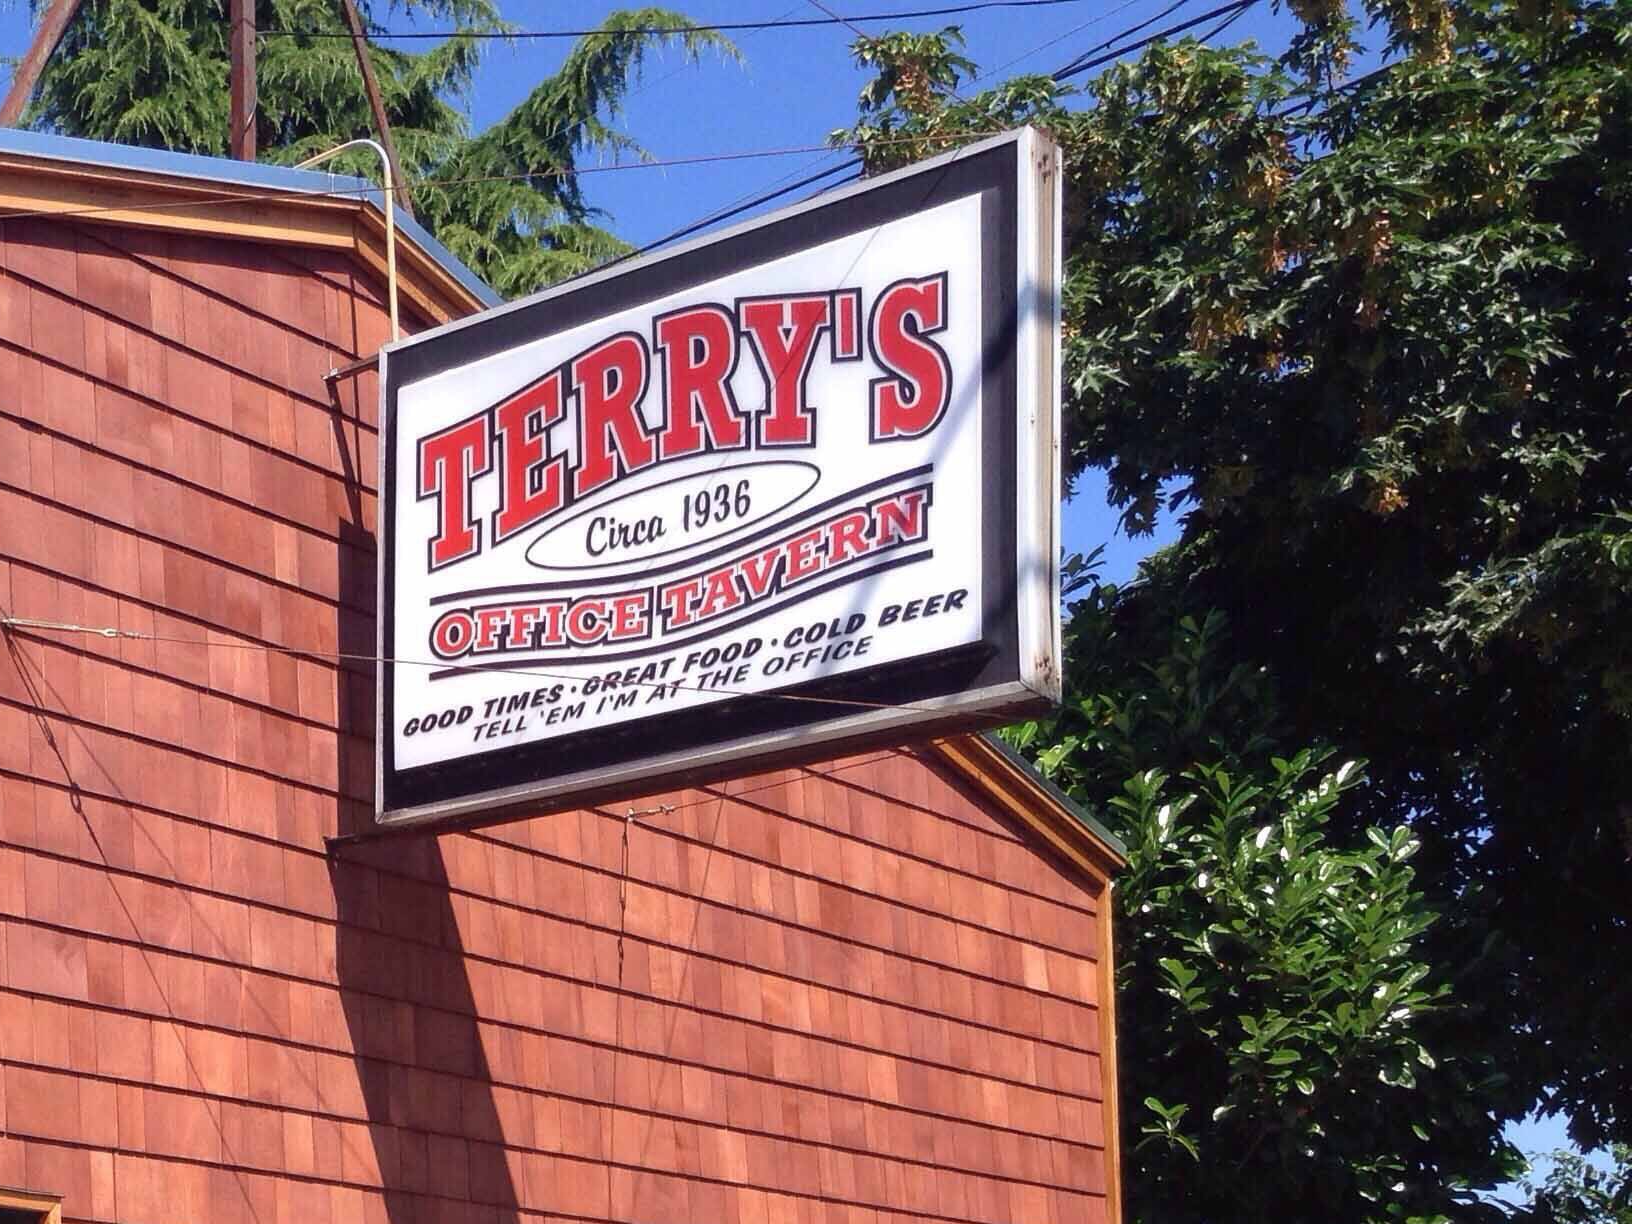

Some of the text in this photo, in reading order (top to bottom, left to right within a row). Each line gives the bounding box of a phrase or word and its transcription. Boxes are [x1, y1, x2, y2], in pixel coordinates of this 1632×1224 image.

[416, 270, 950, 572] TERRY'S
[429, 482, 934, 662] OFFICE TAVERN
[586, 480, 751, 557] Circa 1936
[403, 589, 968, 737] GOOD TIMES GREAT FOOD COLD BEER
[473, 635, 873, 742] TELL 'EM I'M AT THE OFFICE
